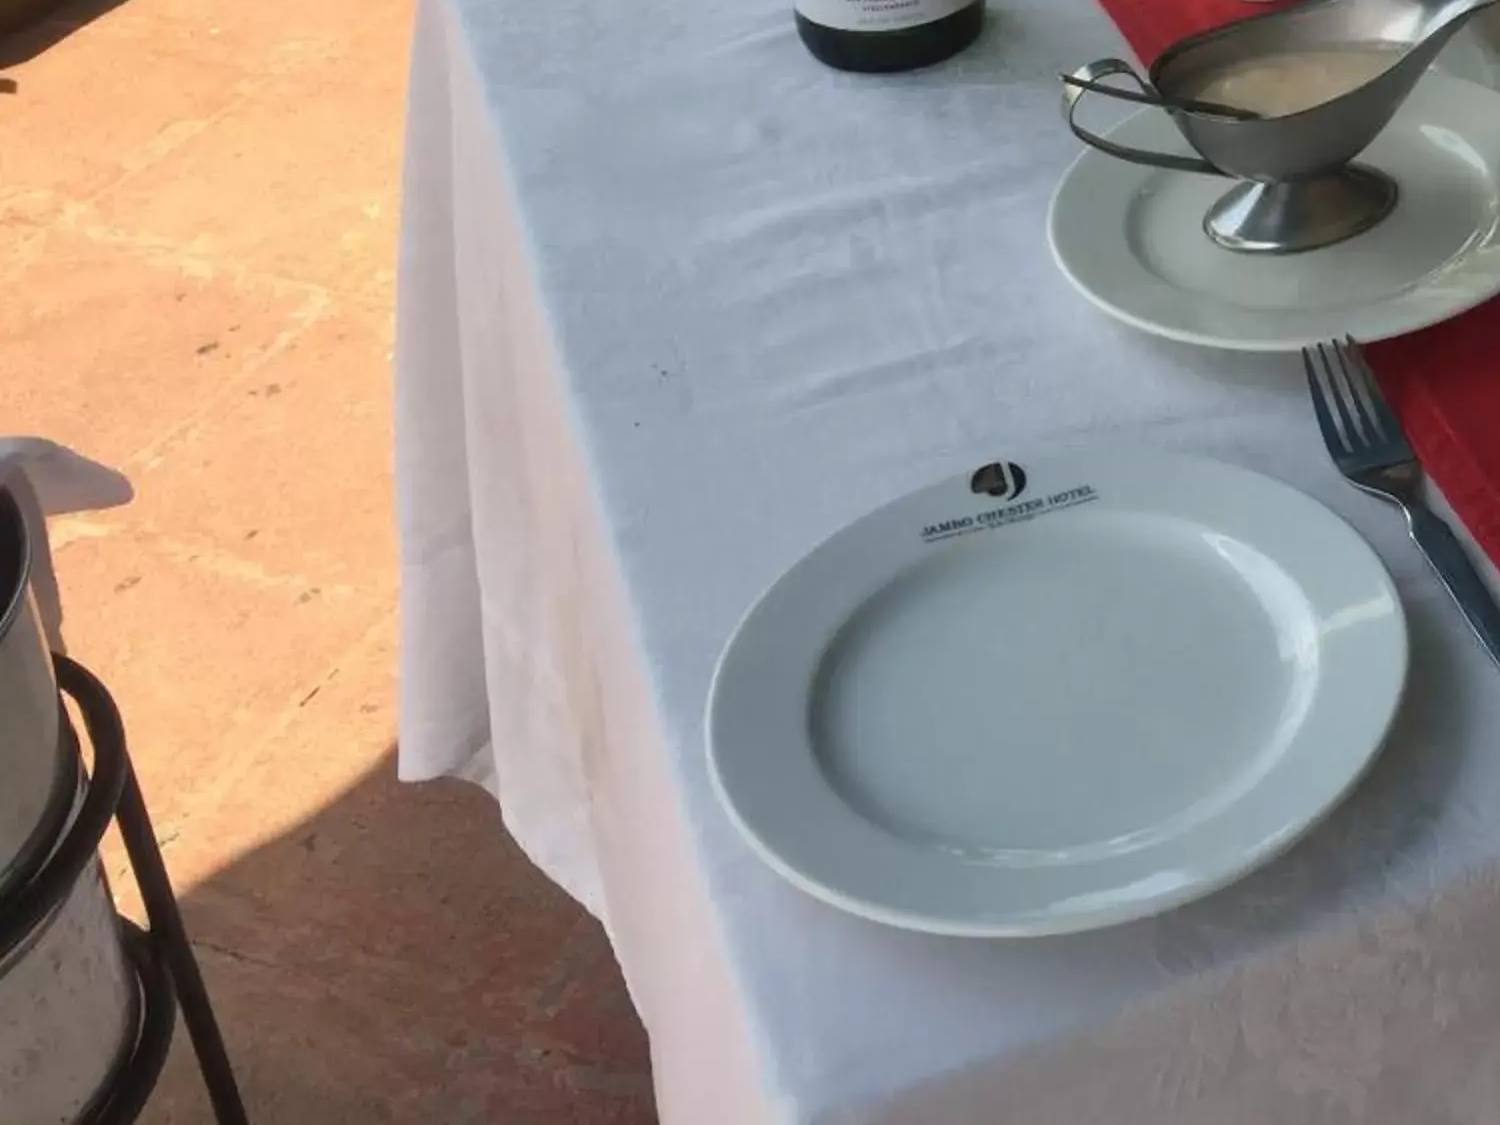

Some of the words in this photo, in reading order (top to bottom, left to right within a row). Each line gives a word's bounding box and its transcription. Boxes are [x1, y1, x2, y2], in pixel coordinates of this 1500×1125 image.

[921, 515, 974, 537] JAMBO
[976, 500, 1045, 525] CHESTER
[1047, 485, 1097, 506] HOTEL
